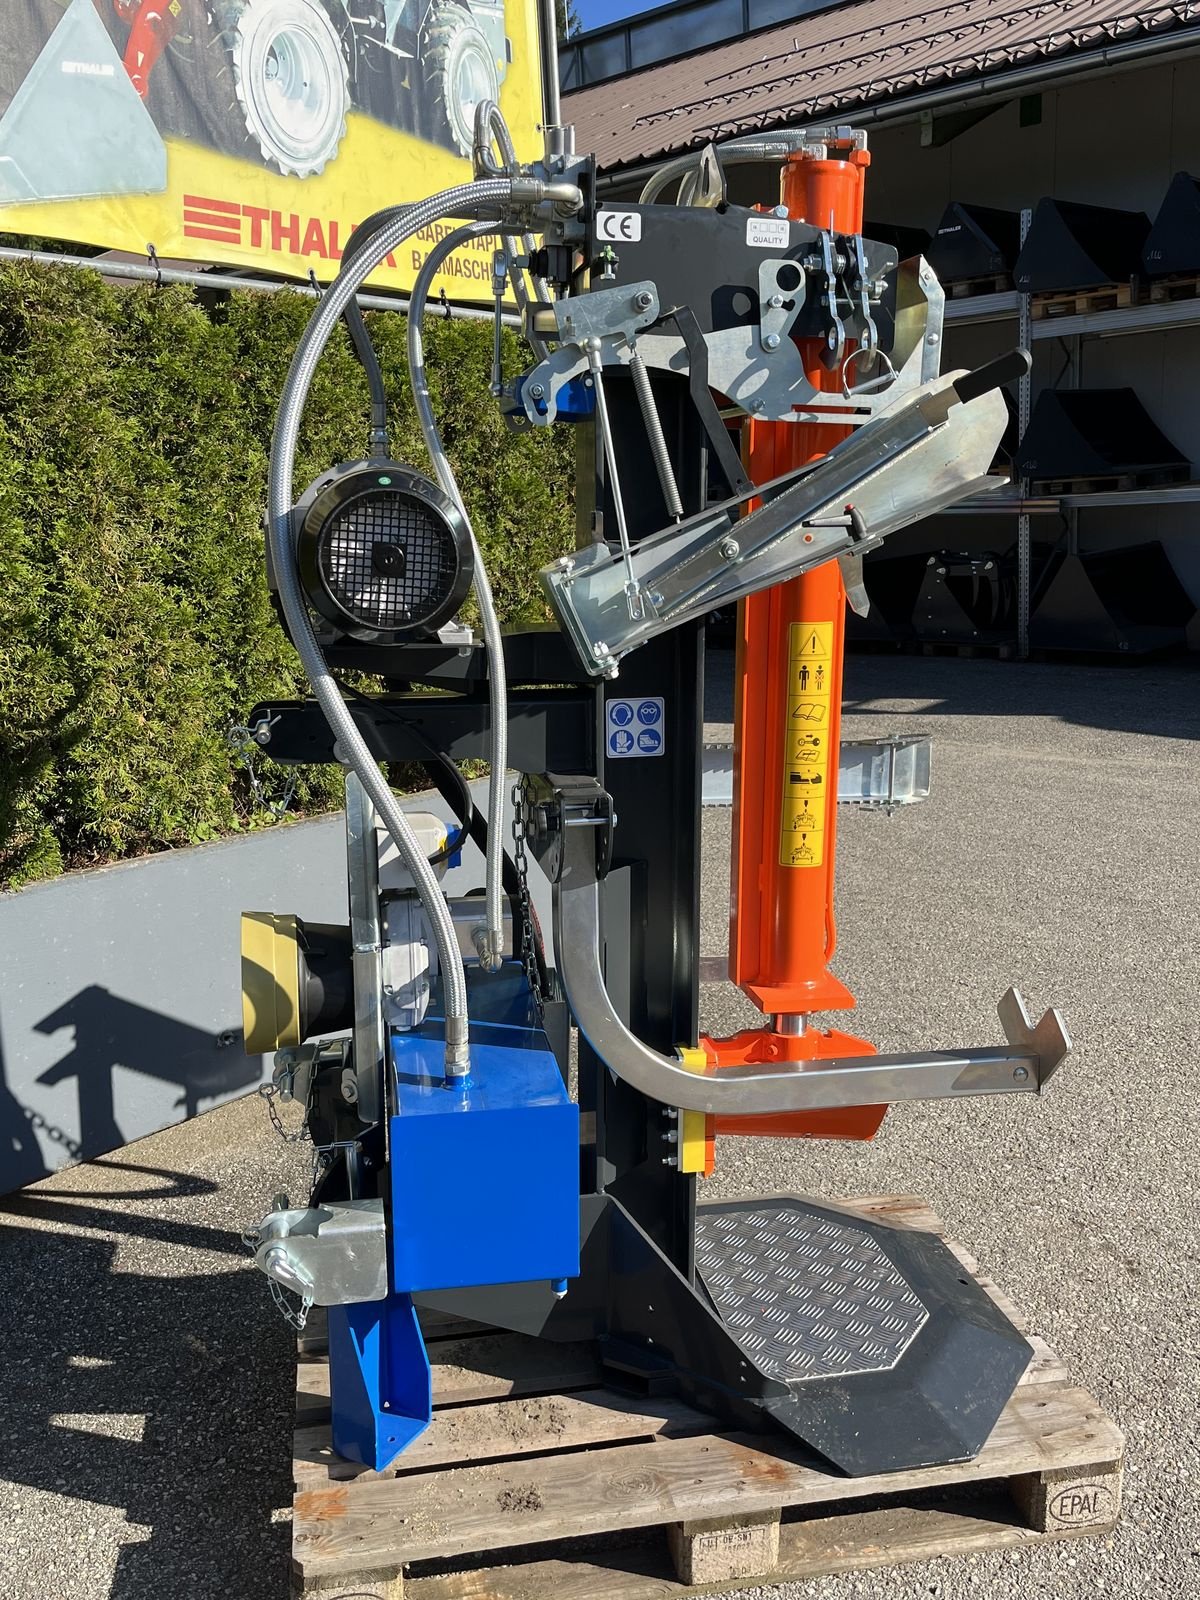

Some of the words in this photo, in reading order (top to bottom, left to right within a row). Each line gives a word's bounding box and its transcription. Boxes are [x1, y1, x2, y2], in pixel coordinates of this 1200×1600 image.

[242, 204, 398, 268] THAL
[603, 214, 633, 240] CE
[752, 236, 783, 244] QUALITY
[1060, 1492, 1100, 1517] EPAL
